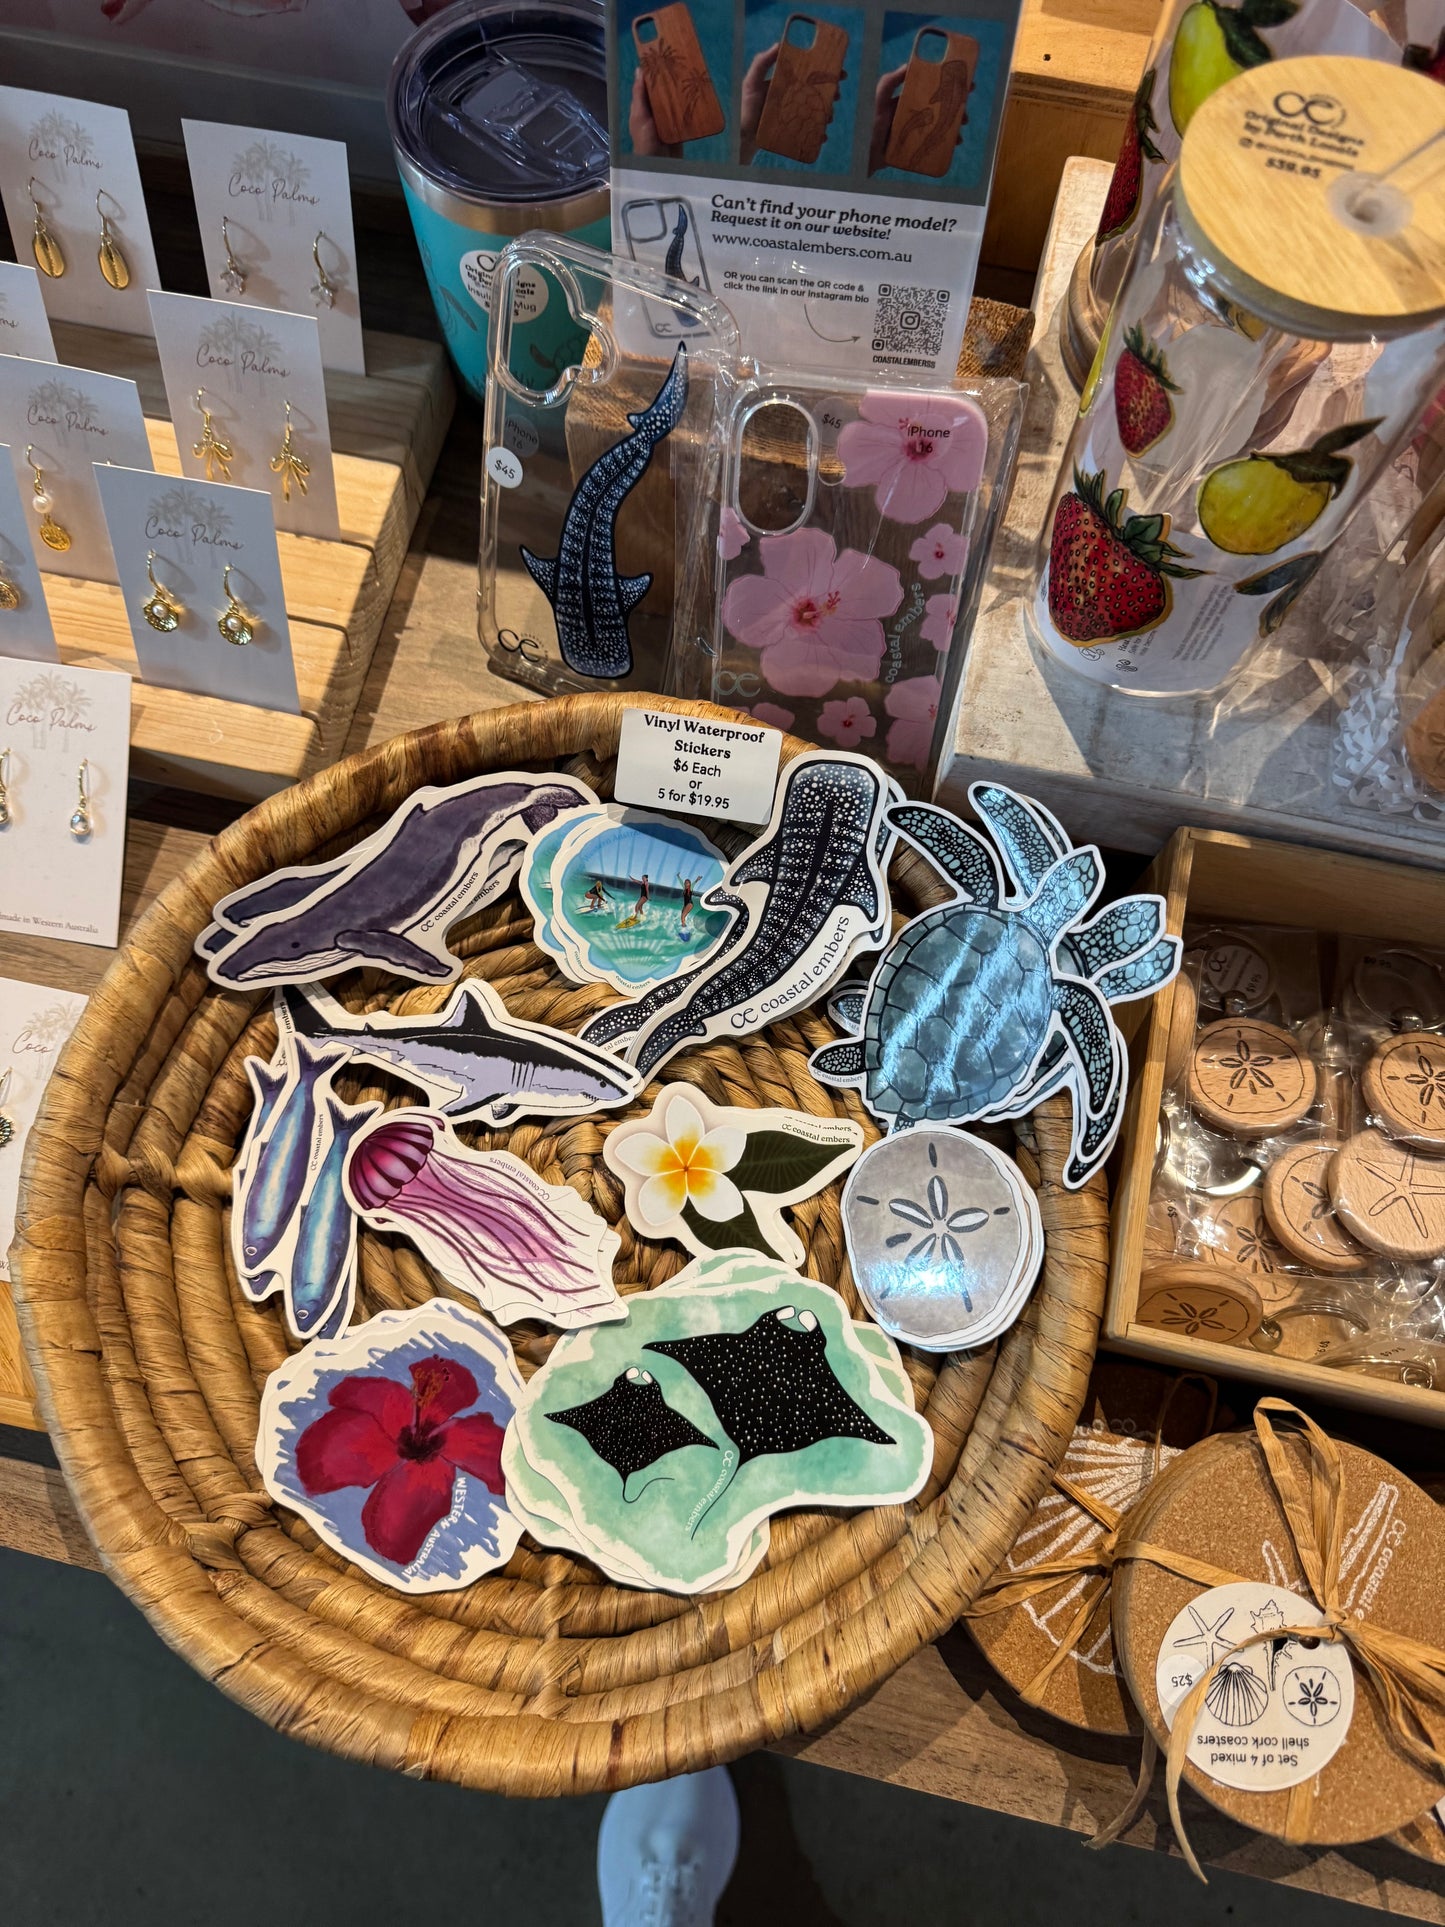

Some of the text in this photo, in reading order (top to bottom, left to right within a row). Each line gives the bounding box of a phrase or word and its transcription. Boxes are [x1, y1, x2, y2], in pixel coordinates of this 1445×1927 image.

[28, 138, 103, 169] Coco Palms
[228, 172, 320, 206] Coco Palms
[711, 194, 957, 233] Can't find your phone model?
[711, 211, 892, 241] Request it on our website!
[712, 233, 912, 263] www.coastalembers.com.au
[465, 264, 536, 288] Origin igns
[724, 271, 738, 280] OR
[739, 274, 757, 283] you
[800, 278, 815, 287] the
[817, 280, 831, 289] QR
[833, 282, 856, 292] code
[857, 285, 864, 293] &
[723, 282, 743, 290] click
[745, 284, 760, 292] the
[762, 286, 778, 294] link
[780, 287, 789, 295] in
[790, 289, 804, 297] our
[855, 294, 869, 303] bio
[514, 301, 536, 312] Mug
[196, 344, 291, 378] Coco Palms
[873, 355, 936, 369] COASTALEMBERSS
[27, 404, 109, 436] Coco Palms
[822, 413, 841, 429] $45
[907, 426, 951, 439] iPhone
[919, 441, 933, 453] 16
[495, 459, 516, 479] $45
[145, 516, 243, 551] Coco Palms
[885, 582, 925, 684] coastal embers
[6, 704, 96, 733] Coco Palms
[644, 713, 766, 744] Vinyl Waterproof
[674, 739, 732, 760] Stickers
[673, 757, 722, 778] $6 Each
[689, 780, 703, 790] or
[657, 788, 731, 810] 5 for $19.95
[434, 896, 460, 921] coastal
[457, 871, 479, 900] embers
[0, 911, 99, 934] made in Western Australia
[760, 972, 815, 1014] coastal
[812, 916, 850, 976] embers
[616, 975, 632, 989] coastal
[12, 1030, 54, 1054] Coco
[822, 1073, 842, 1083] coastal
[793, 1127, 820, 1141] coastal
[314, 1137, 322, 1160] coastal
[489, 1157, 517, 1172] embers
[516, 1170, 540, 1190] coastal
[706, 1469, 727, 1501] coastal
[440, 1477, 467, 1529] WESTERN
[685, 1497, 707, 1531] embers
[1358, 1547, 1393, 1612] coastal
[1171, 1672, 1193, 1687] $25
[1197, 1734, 1310, 1750] shell cork coasters
[1211, 1752, 1299, 1767] Set of 4 mixed
